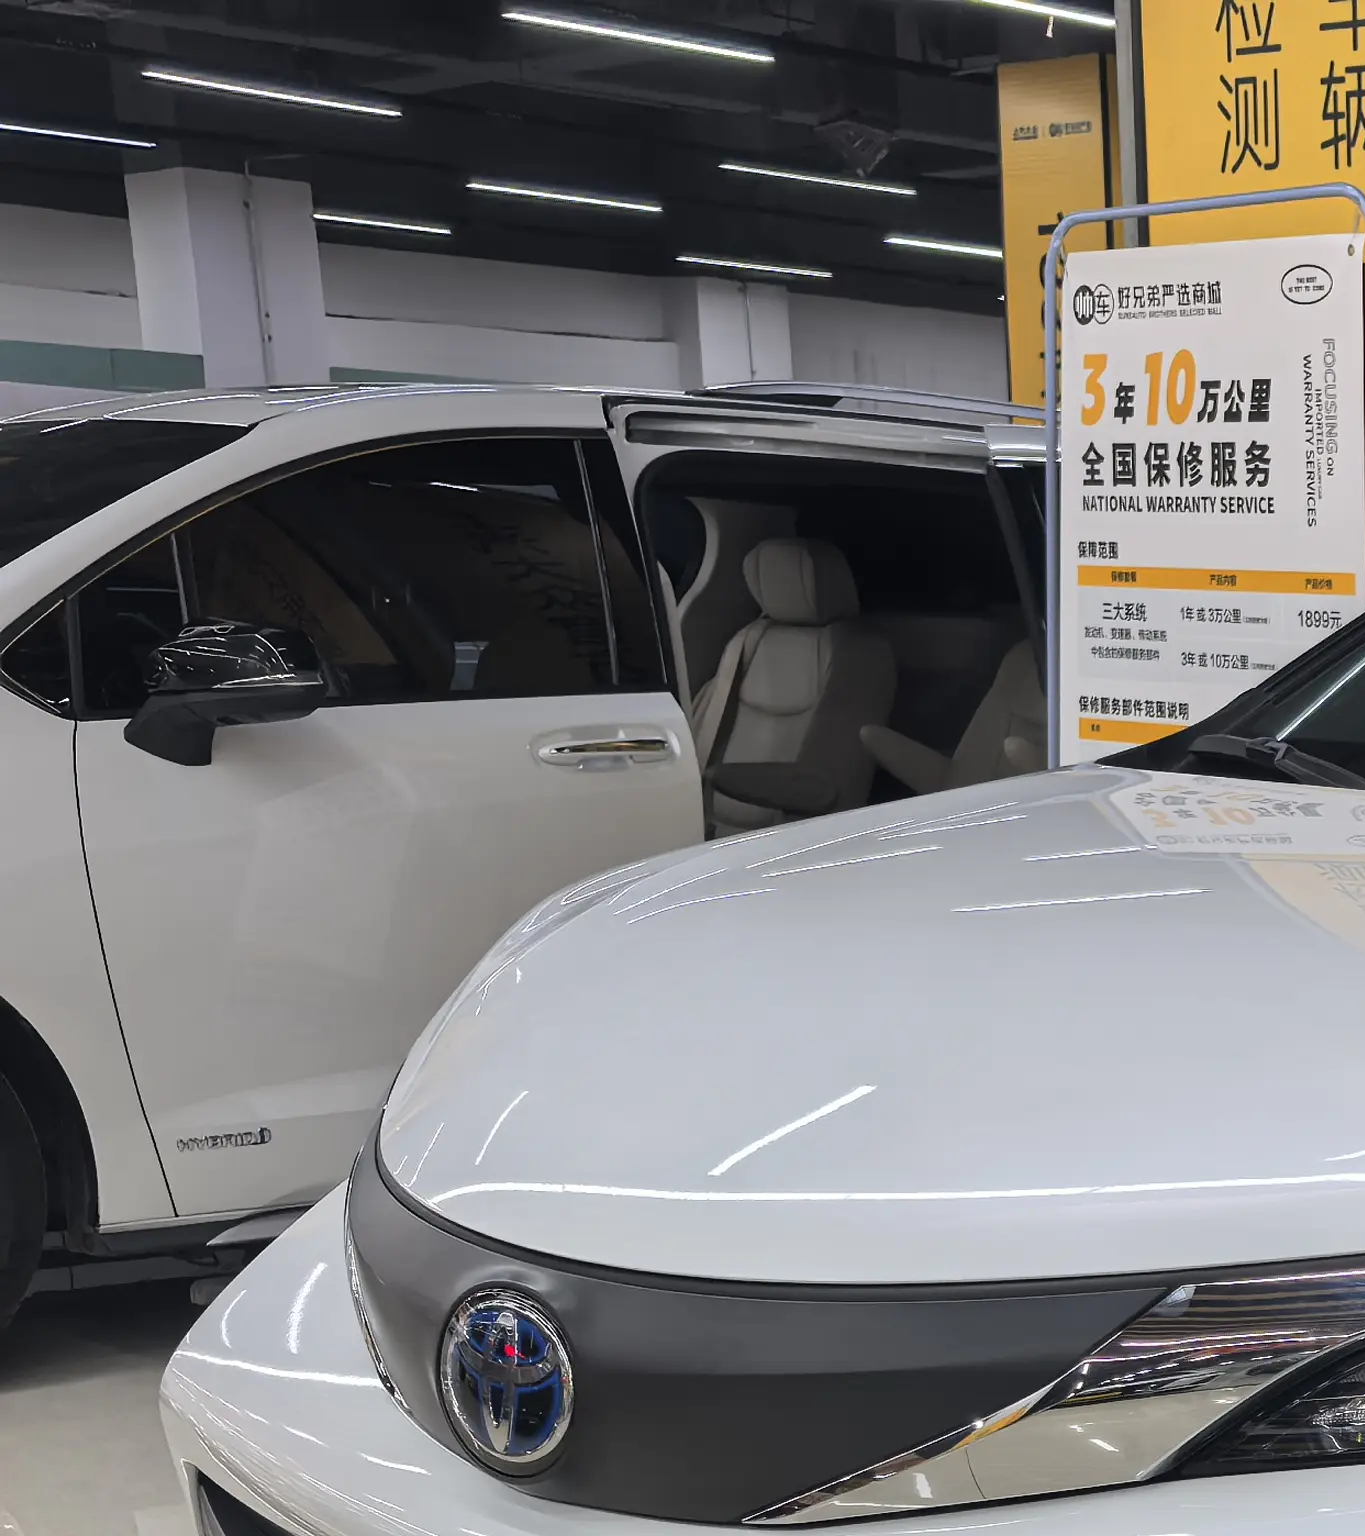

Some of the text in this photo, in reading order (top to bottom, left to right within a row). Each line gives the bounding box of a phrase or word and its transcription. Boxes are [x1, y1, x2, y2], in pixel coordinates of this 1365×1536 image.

[1117, 280, 1222, 310] 好兄弟严选商城
[1314, 388, 1324, 455] IMPORTED
[1323, 338, 1339, 476] FOCUSING ON
[1081, 440, 1272, 488] 全国保修服务
[1303, 353, 1317, 527] WARRANTY SERVICES
[1083, 495, 1275, 514] NATIONAL WARRANTY SERVICE
[1102, 602, 1148, 622] 三大系统
[1298, 610, 1343, 630] 1899元
